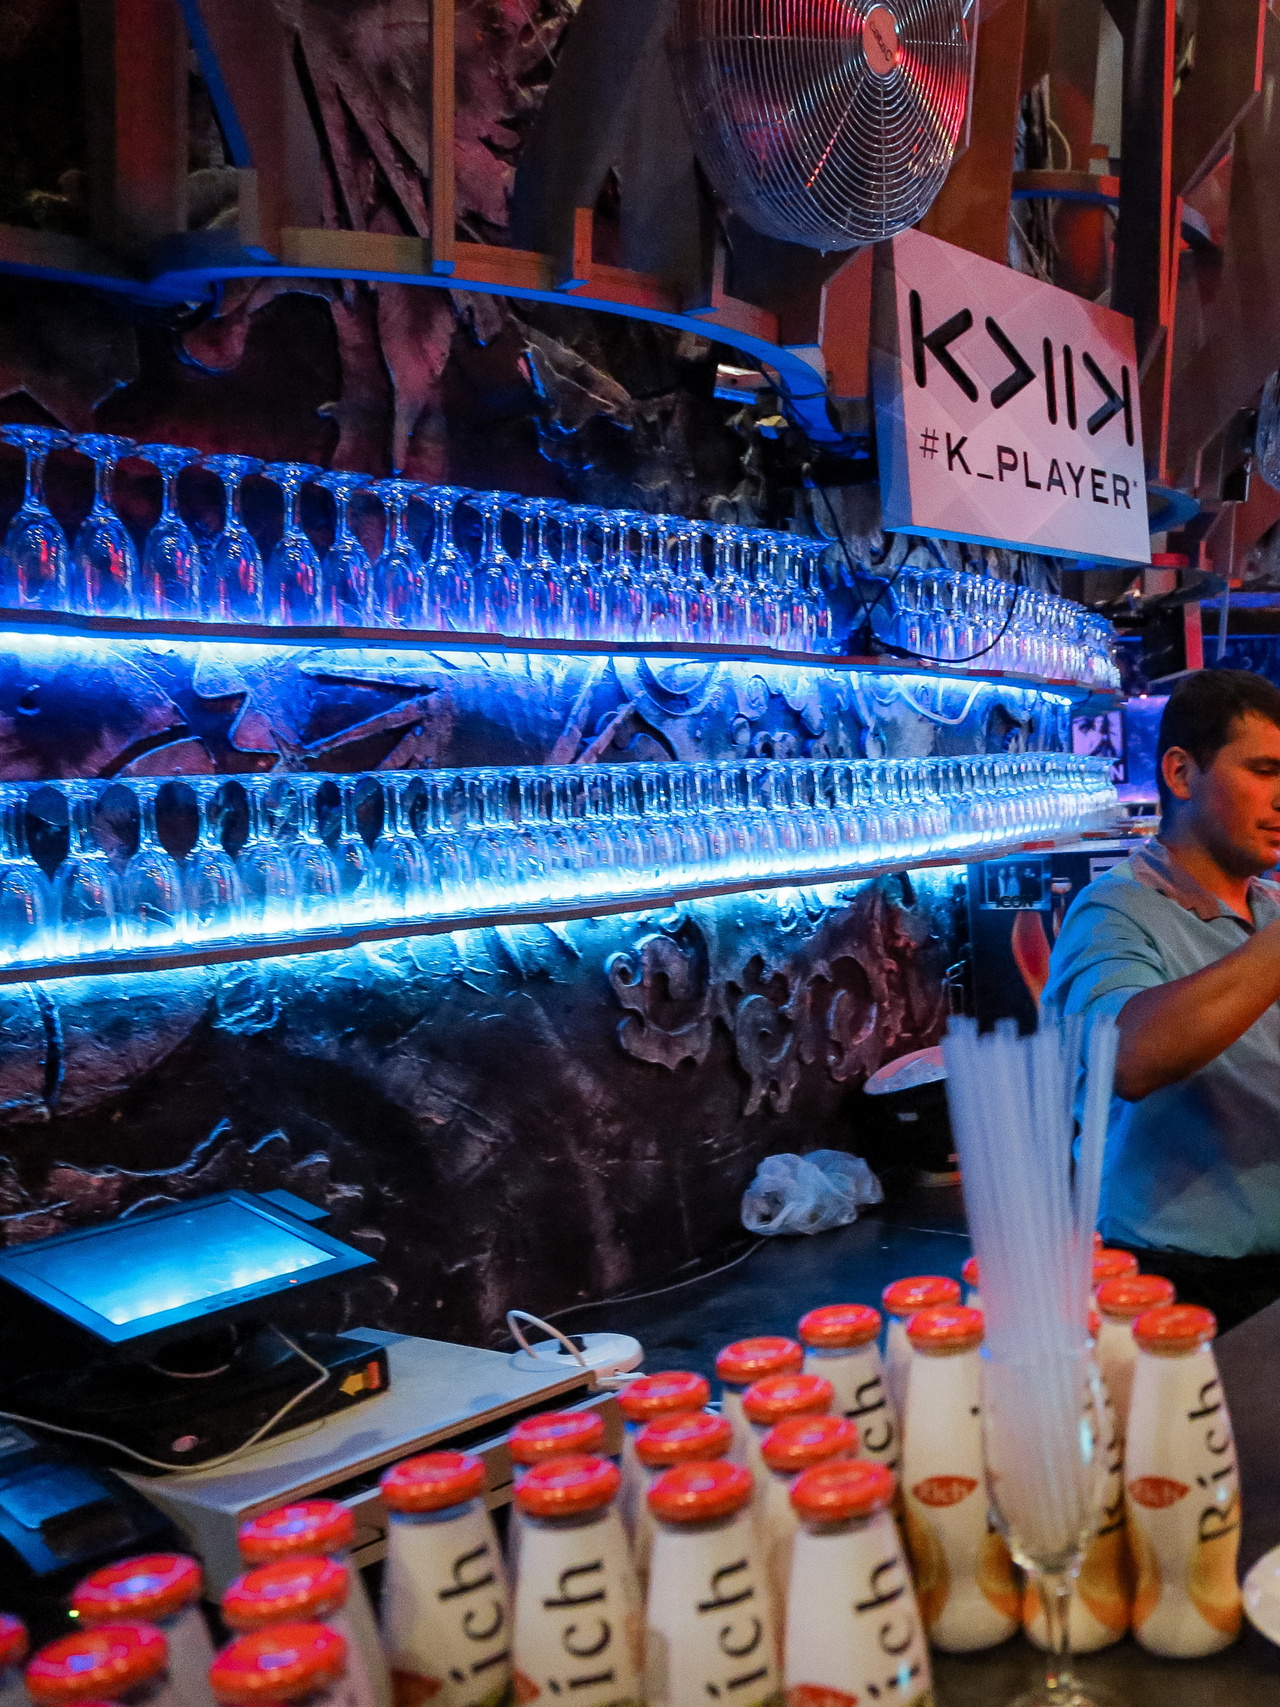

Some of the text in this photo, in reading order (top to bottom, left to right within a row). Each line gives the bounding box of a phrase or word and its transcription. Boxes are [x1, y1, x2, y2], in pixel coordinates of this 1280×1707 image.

[919, 427, 1132, 510] #K_PLAYER
[1188, 1379, 1240, 1544] Rich
[438, 1542, 511, 1684] ich
[542, 1558, 616, 1696] ich
[696, 1557, 769, 1699] ich
[855, 1556, 920, 1699] ich
